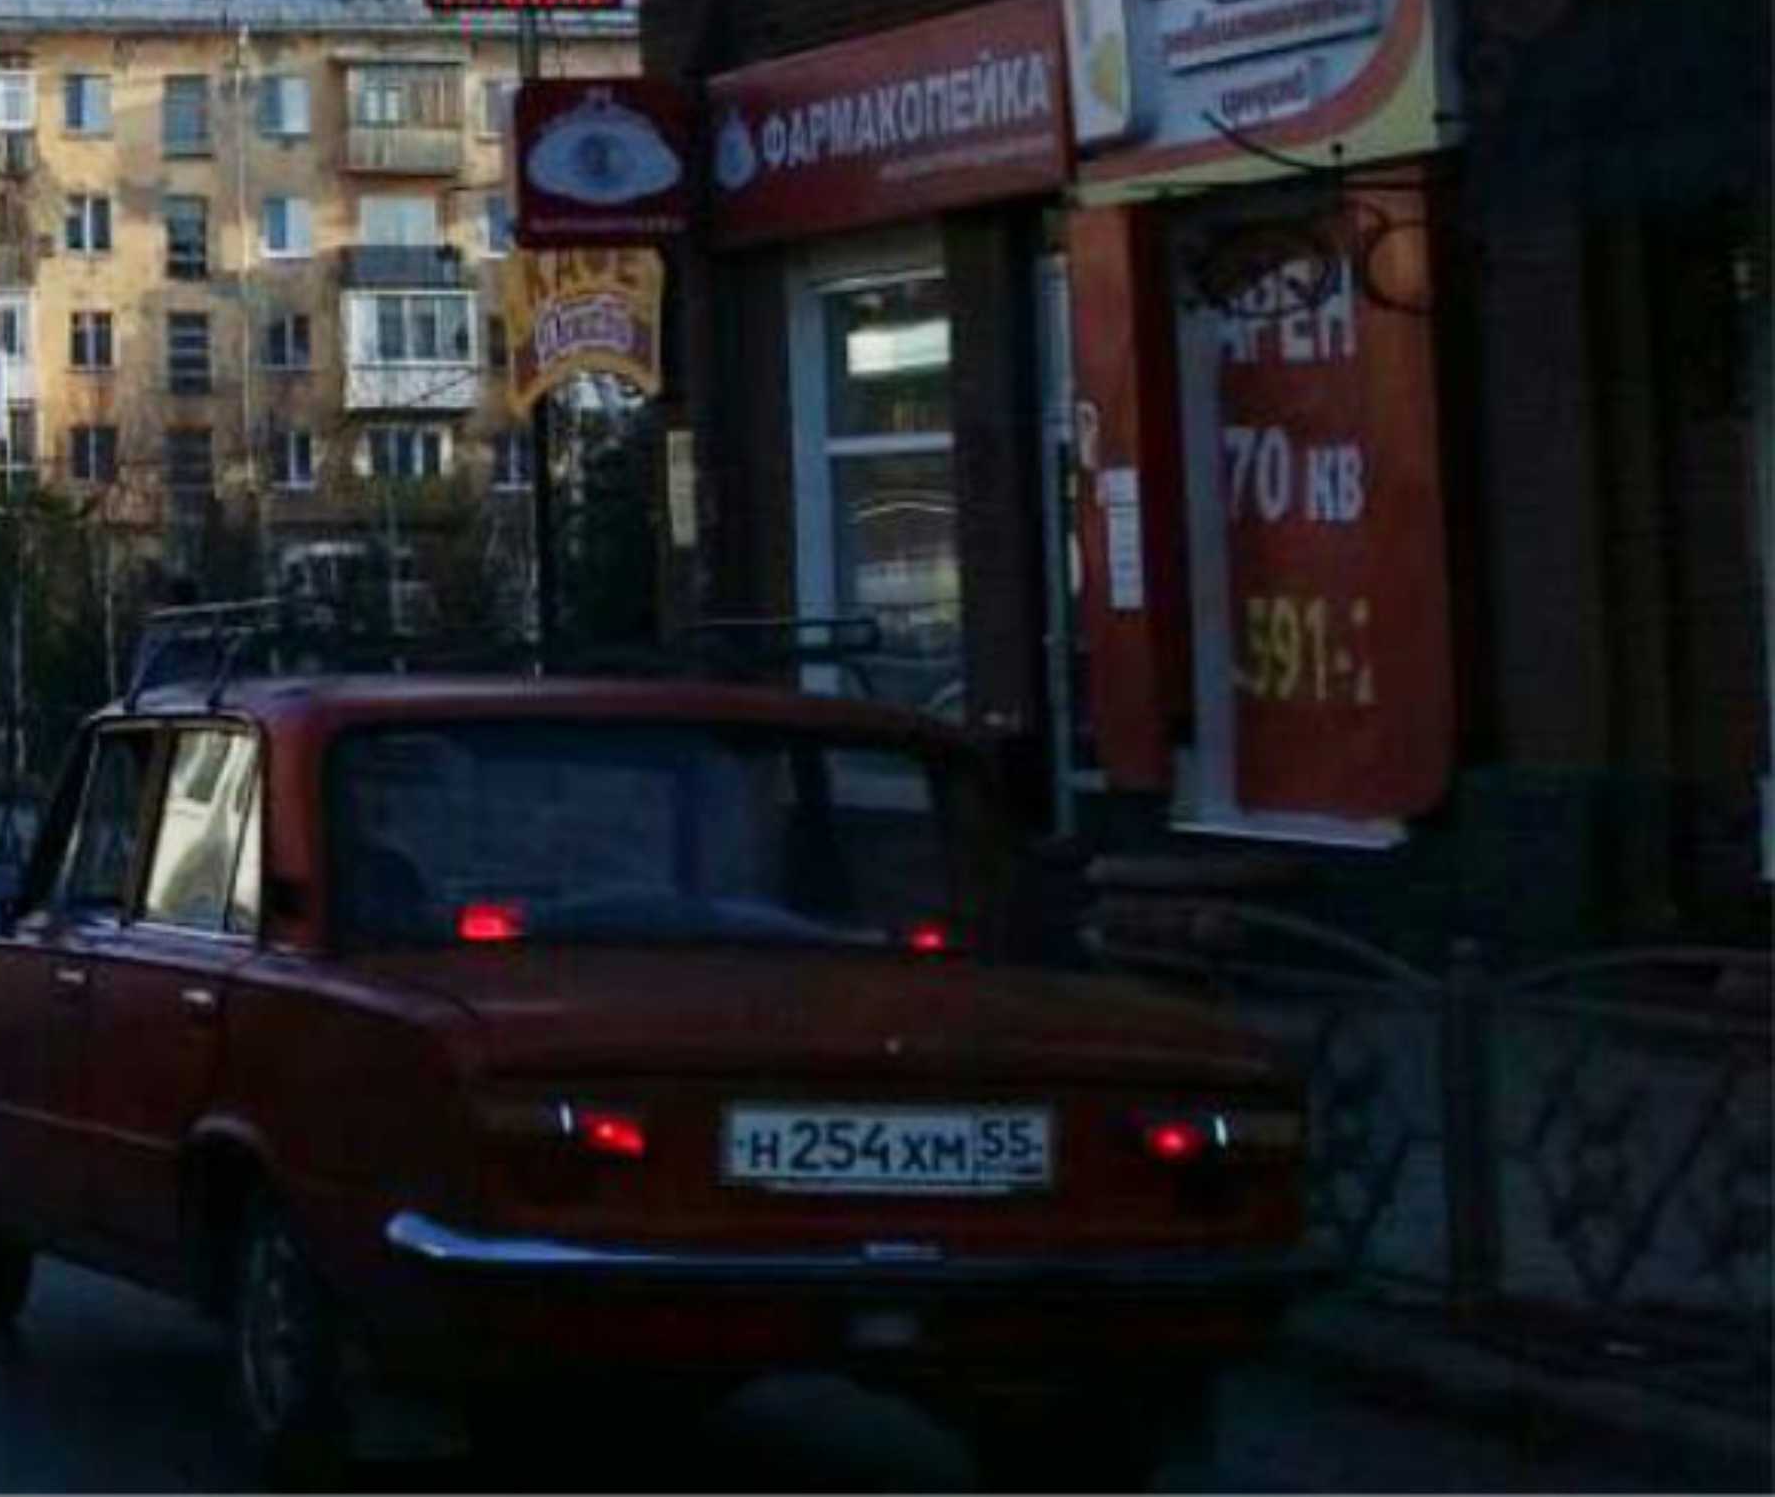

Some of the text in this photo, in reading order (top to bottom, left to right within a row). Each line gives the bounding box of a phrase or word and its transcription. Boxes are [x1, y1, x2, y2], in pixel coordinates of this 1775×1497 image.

[762, 49, 1050, 171] ФАРМАКОПЕЙКА
[1223, 426, 1291, 521] 70
[750, 1119, 1033, 1174] Н254ХМ 55
